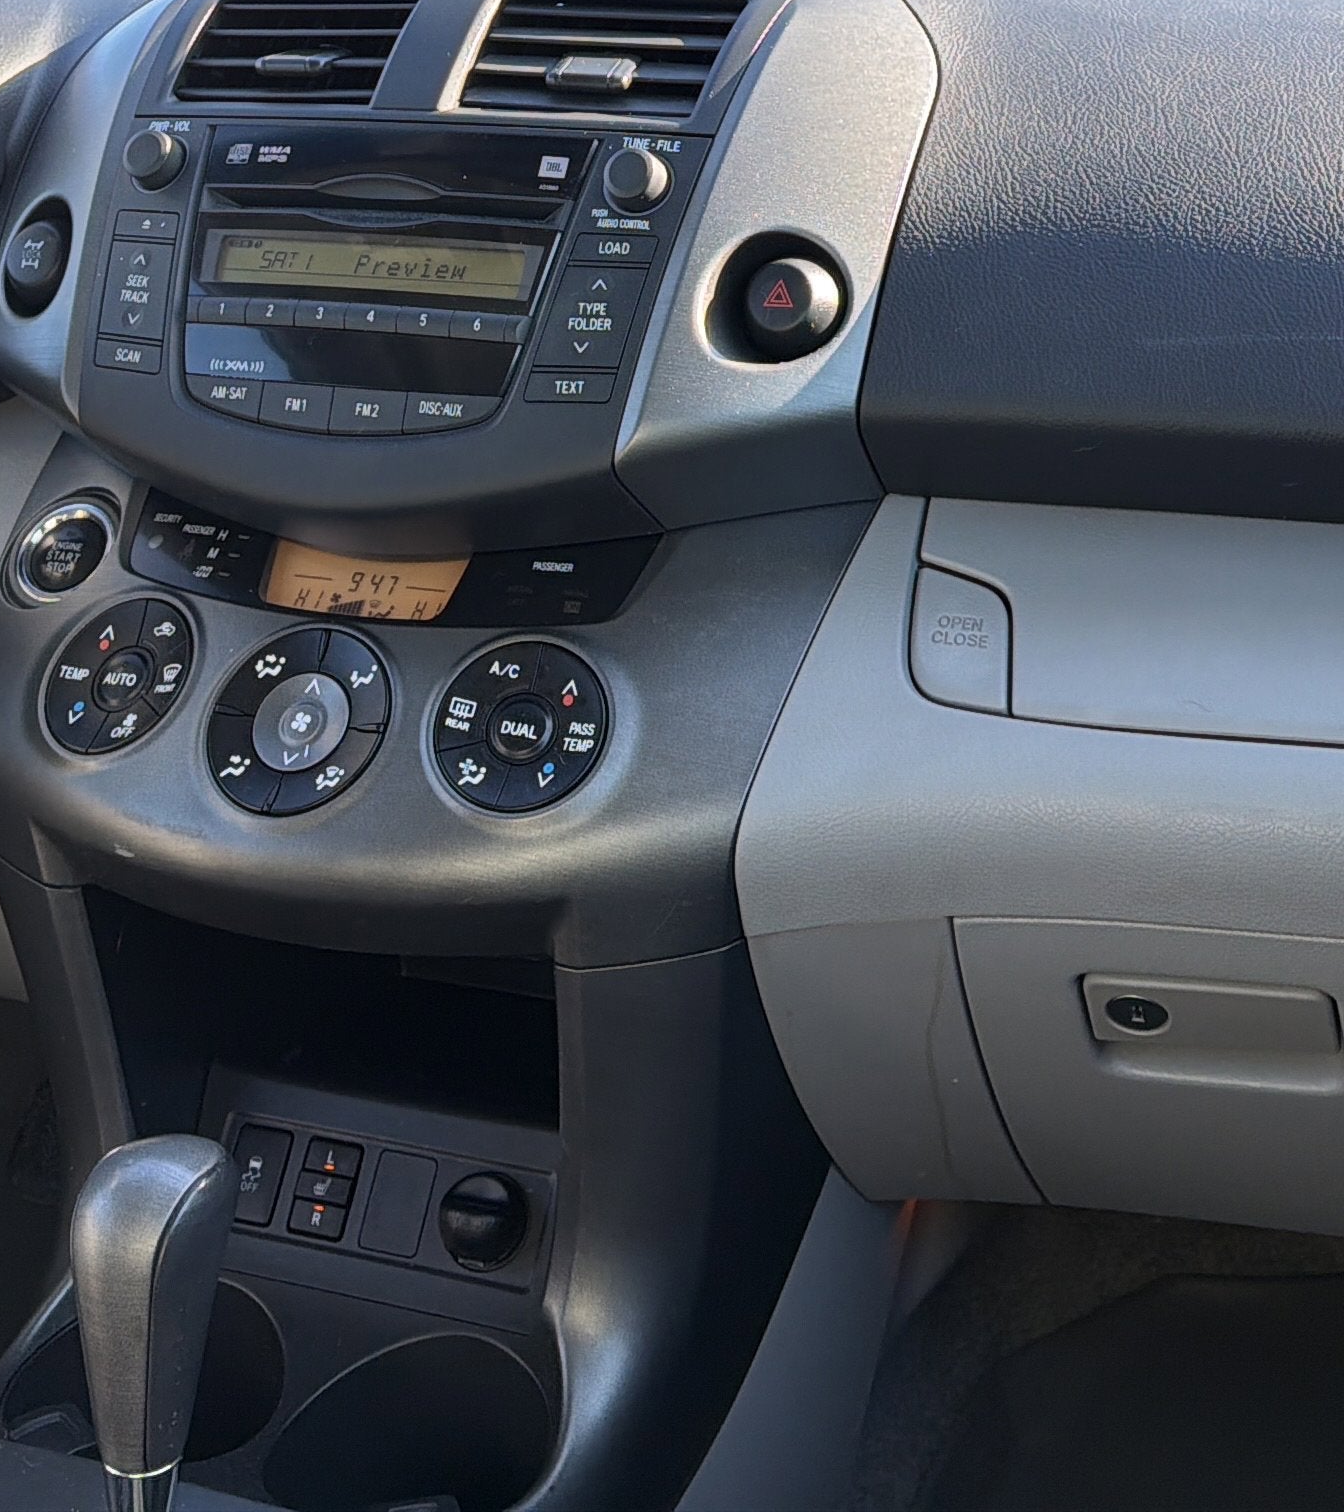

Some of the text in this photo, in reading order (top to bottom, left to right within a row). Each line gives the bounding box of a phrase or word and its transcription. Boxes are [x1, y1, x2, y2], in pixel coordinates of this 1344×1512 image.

[596, 218, 651, 231] AUDIO CONTROL
[598, 241, 630, 255] LOAD
[352, 253, 469, 281] Preview
[125, 273, 150, 288] SEEK
[119, 289, 150, 304] TRACK
[219, 303, 226, 315] 1
[265, 304, 274, 318] 2
[315, 307, 324, 320] 3
[577, 302, 608, 315] TYPE
[365, 310, 375, 323] 4
[418, 313, 429, 327] 5
[472, 318, 482, 331] 6
[567, 317, 612, 331] FOLDER
[114, 347, 142, 364] SCAN
[554, 380, 585, 395] TEXT
[153, 513, 183, 524] SECURITY
[182, 523, 216, 536] PASSENGER
[216, 529, 229, 542] H
[52, 539, 84, 552] ENGINE
[45, 550, 82, 563] START
[206, 547, 220, 560] M
[45, 560, 74, 574] STOP
[532, 560, 575, 573] PASSENGER
[937, 614, 984, 632] OPEN
[931, 630, 989, 648] CLOSE
[59, 664, 90, 681] TEMP
[489, 660, 520, 679] A/C
[102, 672, 137, 687] AUTO
[154, 683, 176, 694] FRONT
[445, 717, 471, 732] REAR
[500, 720, 537, 740] DUAL
[568, 721, 596, 737] PASS
[110, 726, 136, 738] OFF
[562, 737, 594, 753] TEMP
[326, 1149, 334, 1164] L
[240, 1180, 260, 1194] OFF
[310, 1212, 321, 1227] R
